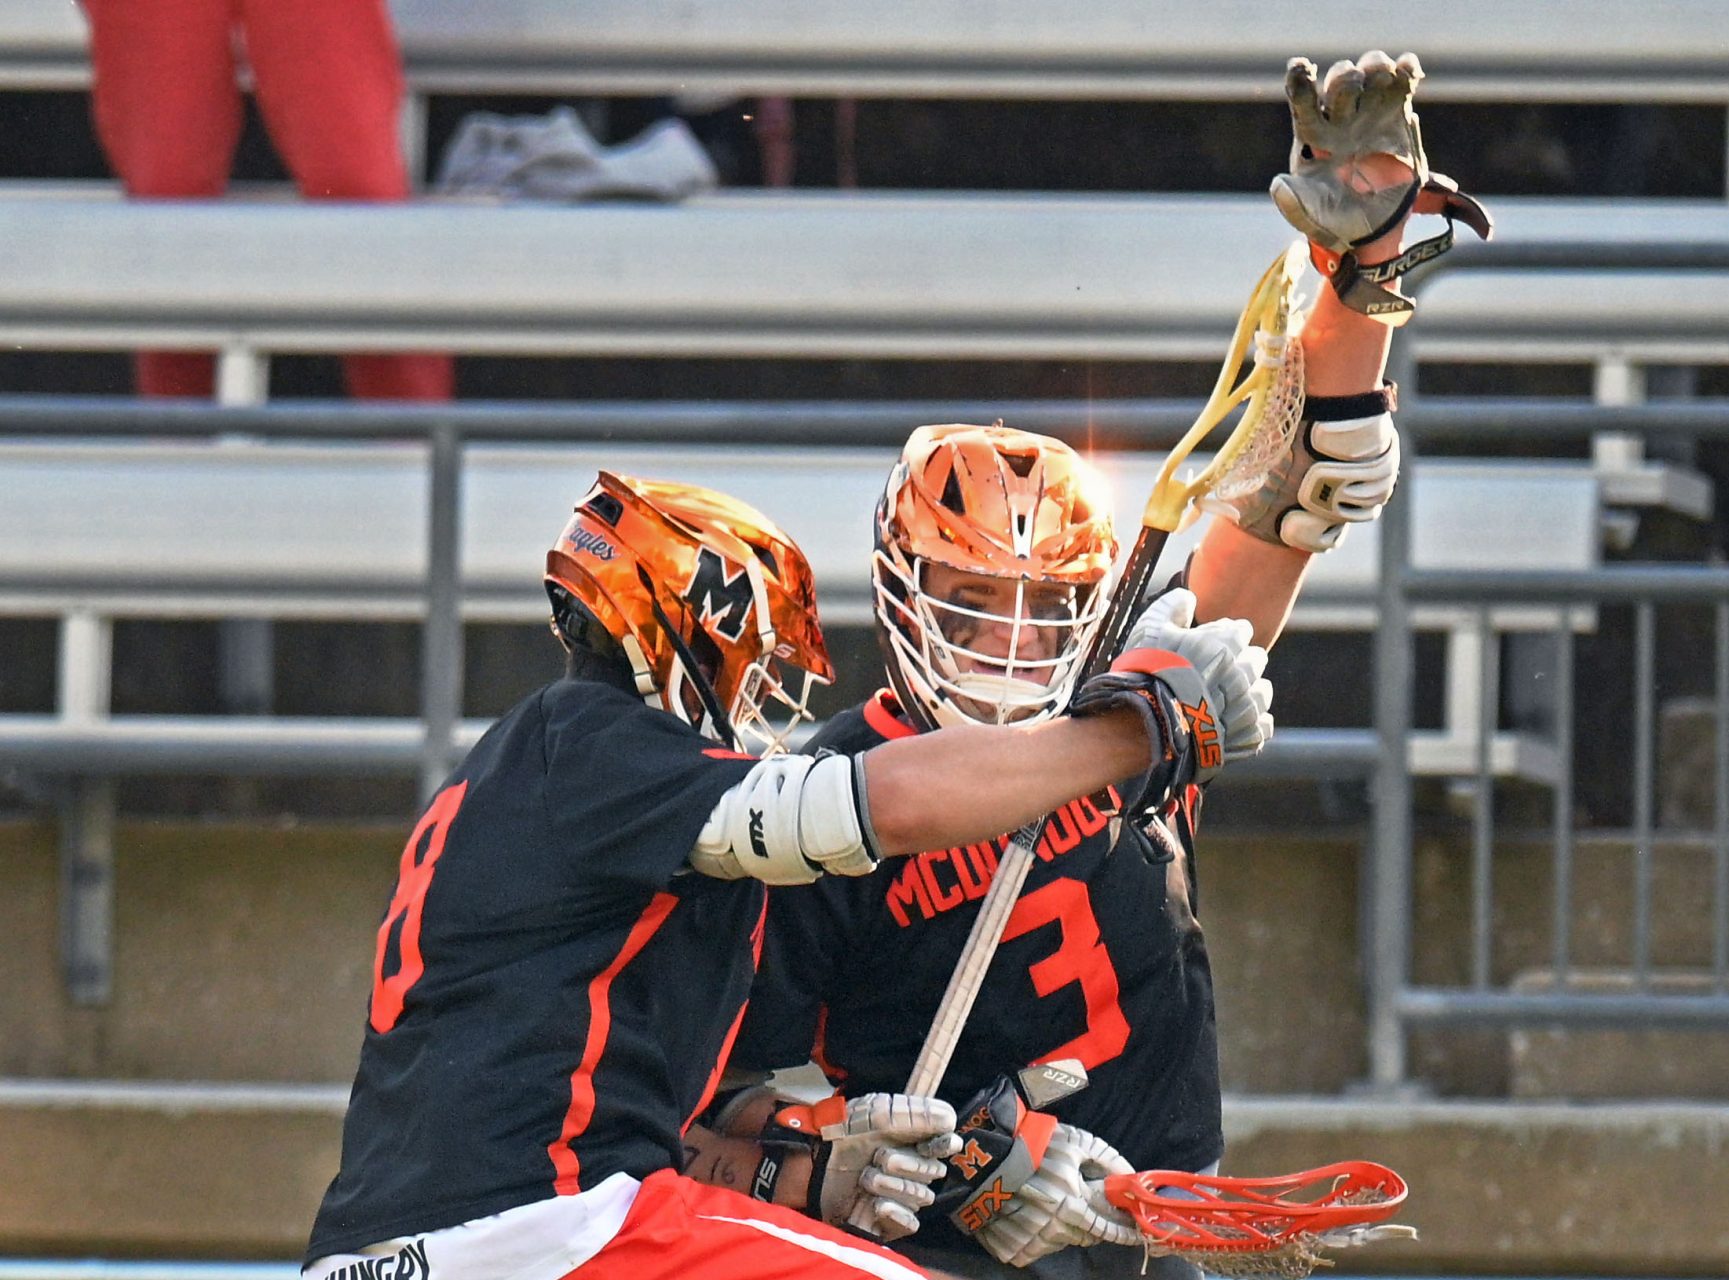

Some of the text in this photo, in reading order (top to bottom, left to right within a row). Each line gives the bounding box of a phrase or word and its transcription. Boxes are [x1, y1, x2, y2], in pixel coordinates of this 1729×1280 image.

[1366, 301, 1404, 314] RZR
[681, 543, 756, 643] M
[1181, 696, 1222, 768] STX
[370, 779, 468, 1034] 8
[1000, 876, 1132, 1071] 3
[1043, 1067, 1080, 1090] RZR
[950, 1138, 993, 1180] M
[959, 1177, 1015, 1231] STX
